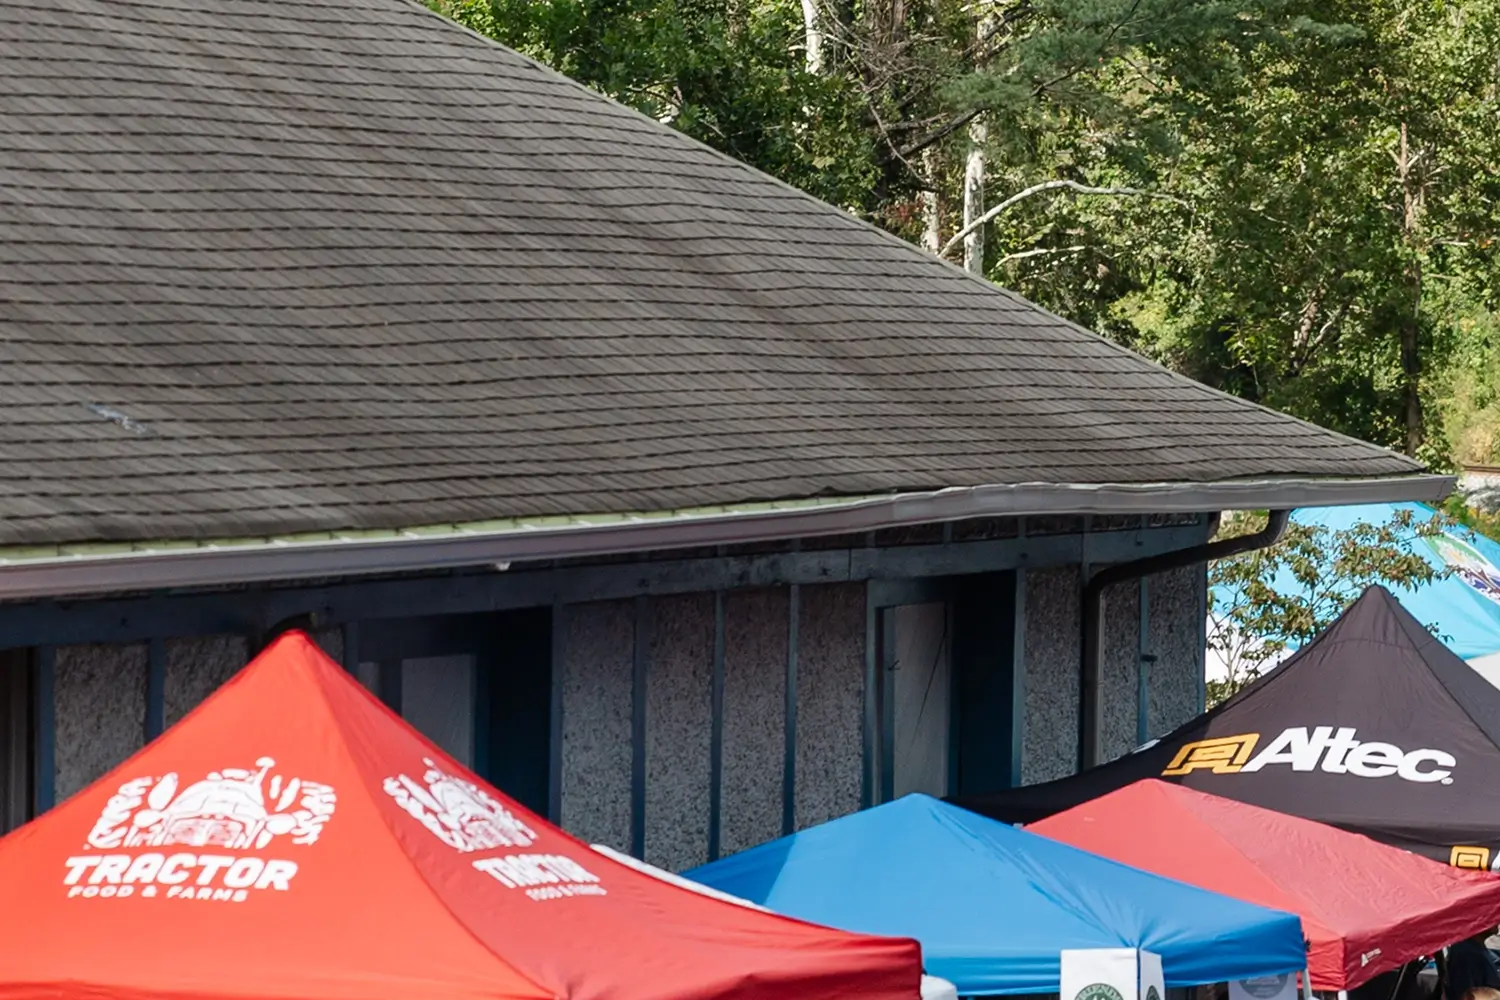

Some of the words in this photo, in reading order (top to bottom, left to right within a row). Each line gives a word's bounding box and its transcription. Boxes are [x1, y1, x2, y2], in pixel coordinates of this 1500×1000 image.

[1240, 726, 1457, 785] Altec
[64, 853, 299, 891] TRACTOR
[67, 885, 135, 899] FOOD
[141, 885, 157, 898] &
[166, 886, 249, 903] FARMS
